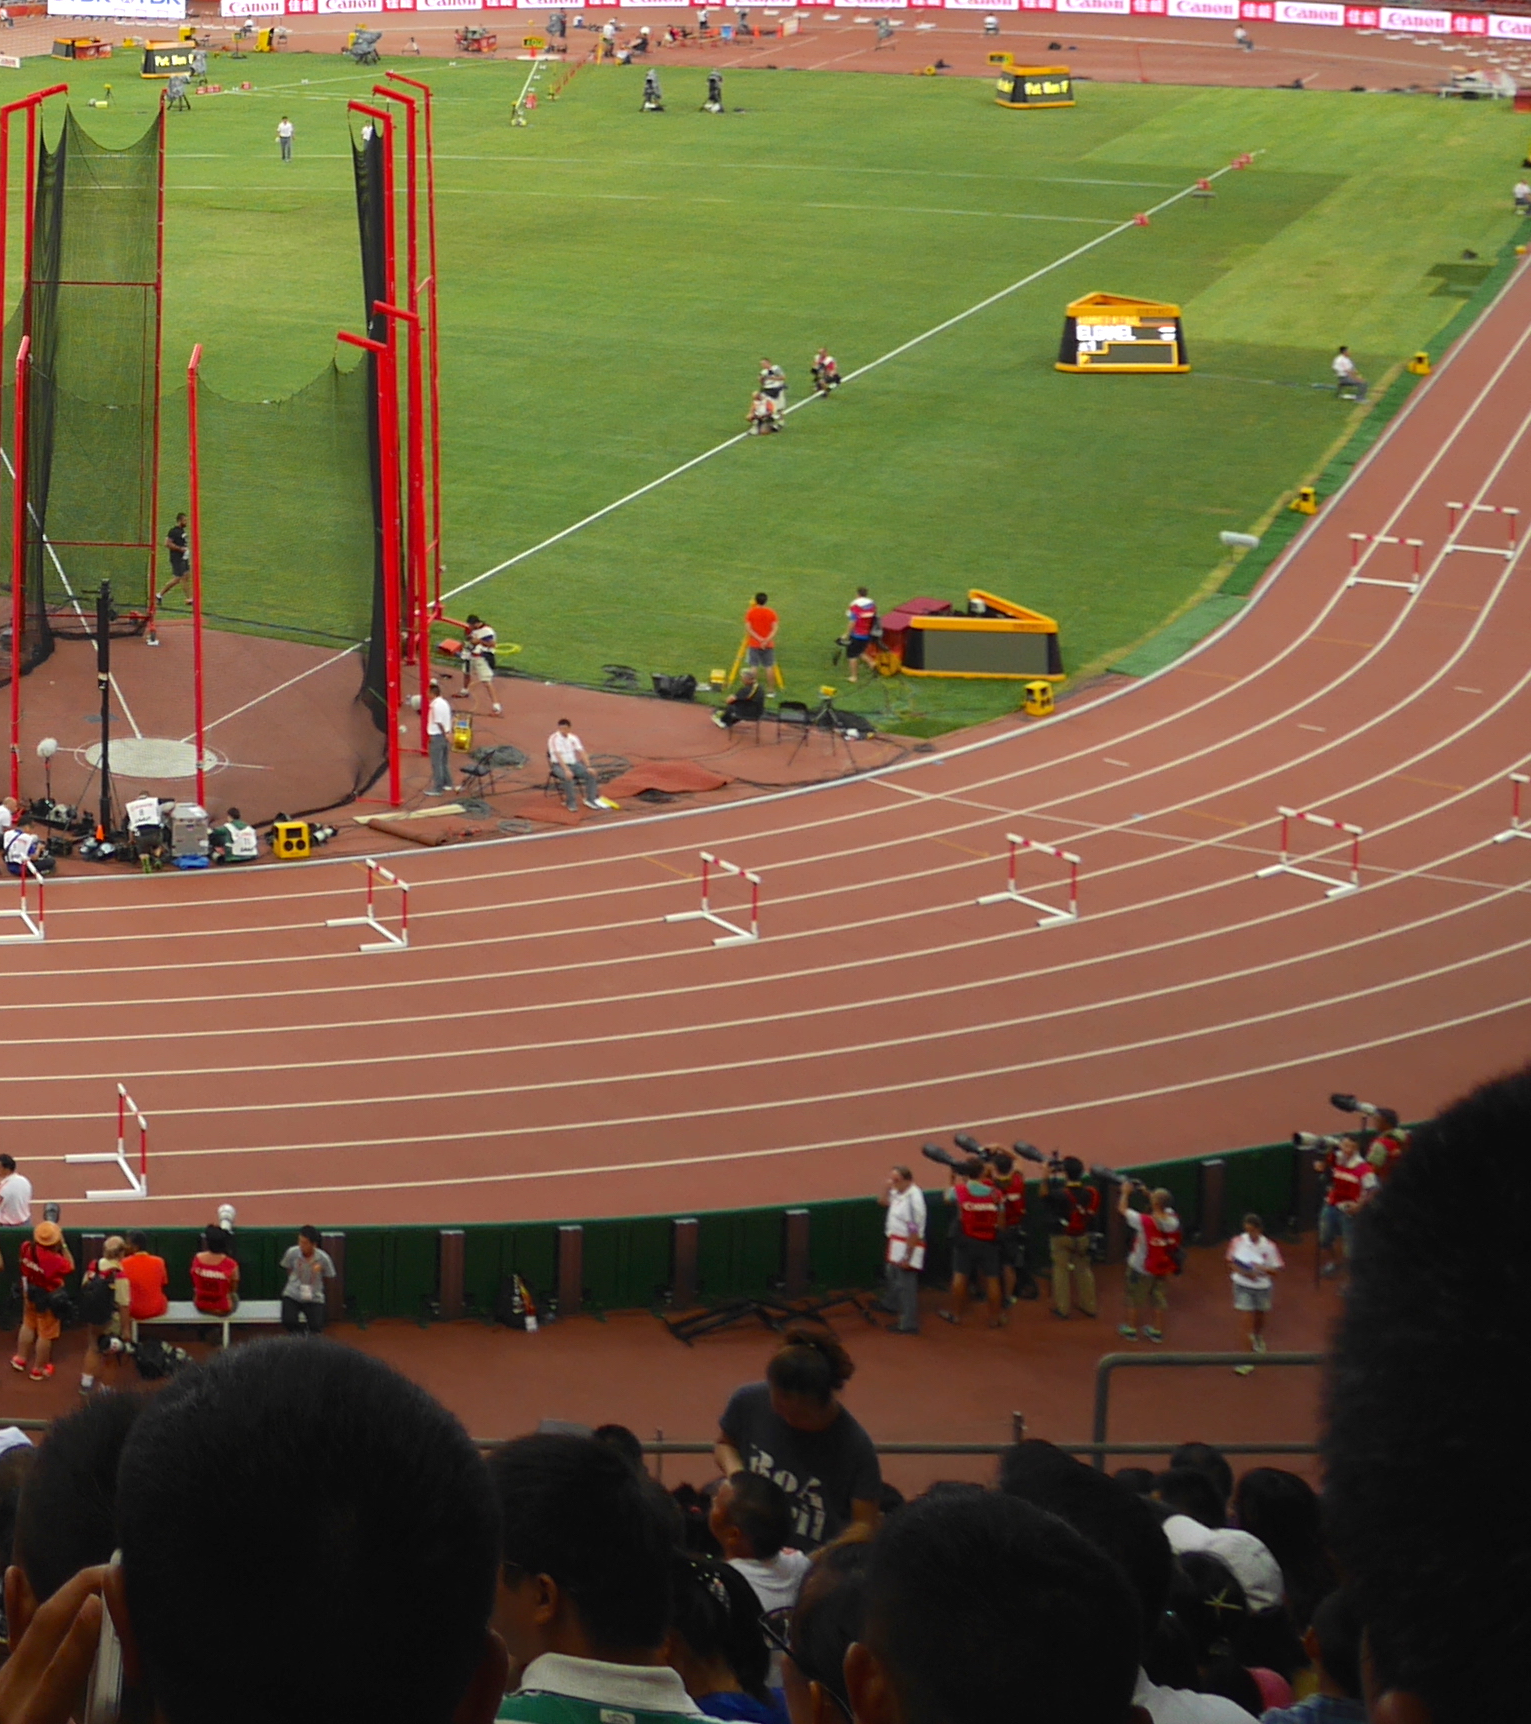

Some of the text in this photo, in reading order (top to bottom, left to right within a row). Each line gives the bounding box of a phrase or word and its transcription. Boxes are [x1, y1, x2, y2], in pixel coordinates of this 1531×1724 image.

[229, 1, 279, 14] Canon
[1176, 0, 1234, 15] Canon
[1283, 5, 1340, 21] Canon
[1388, 12, 1446, 29] Canon
